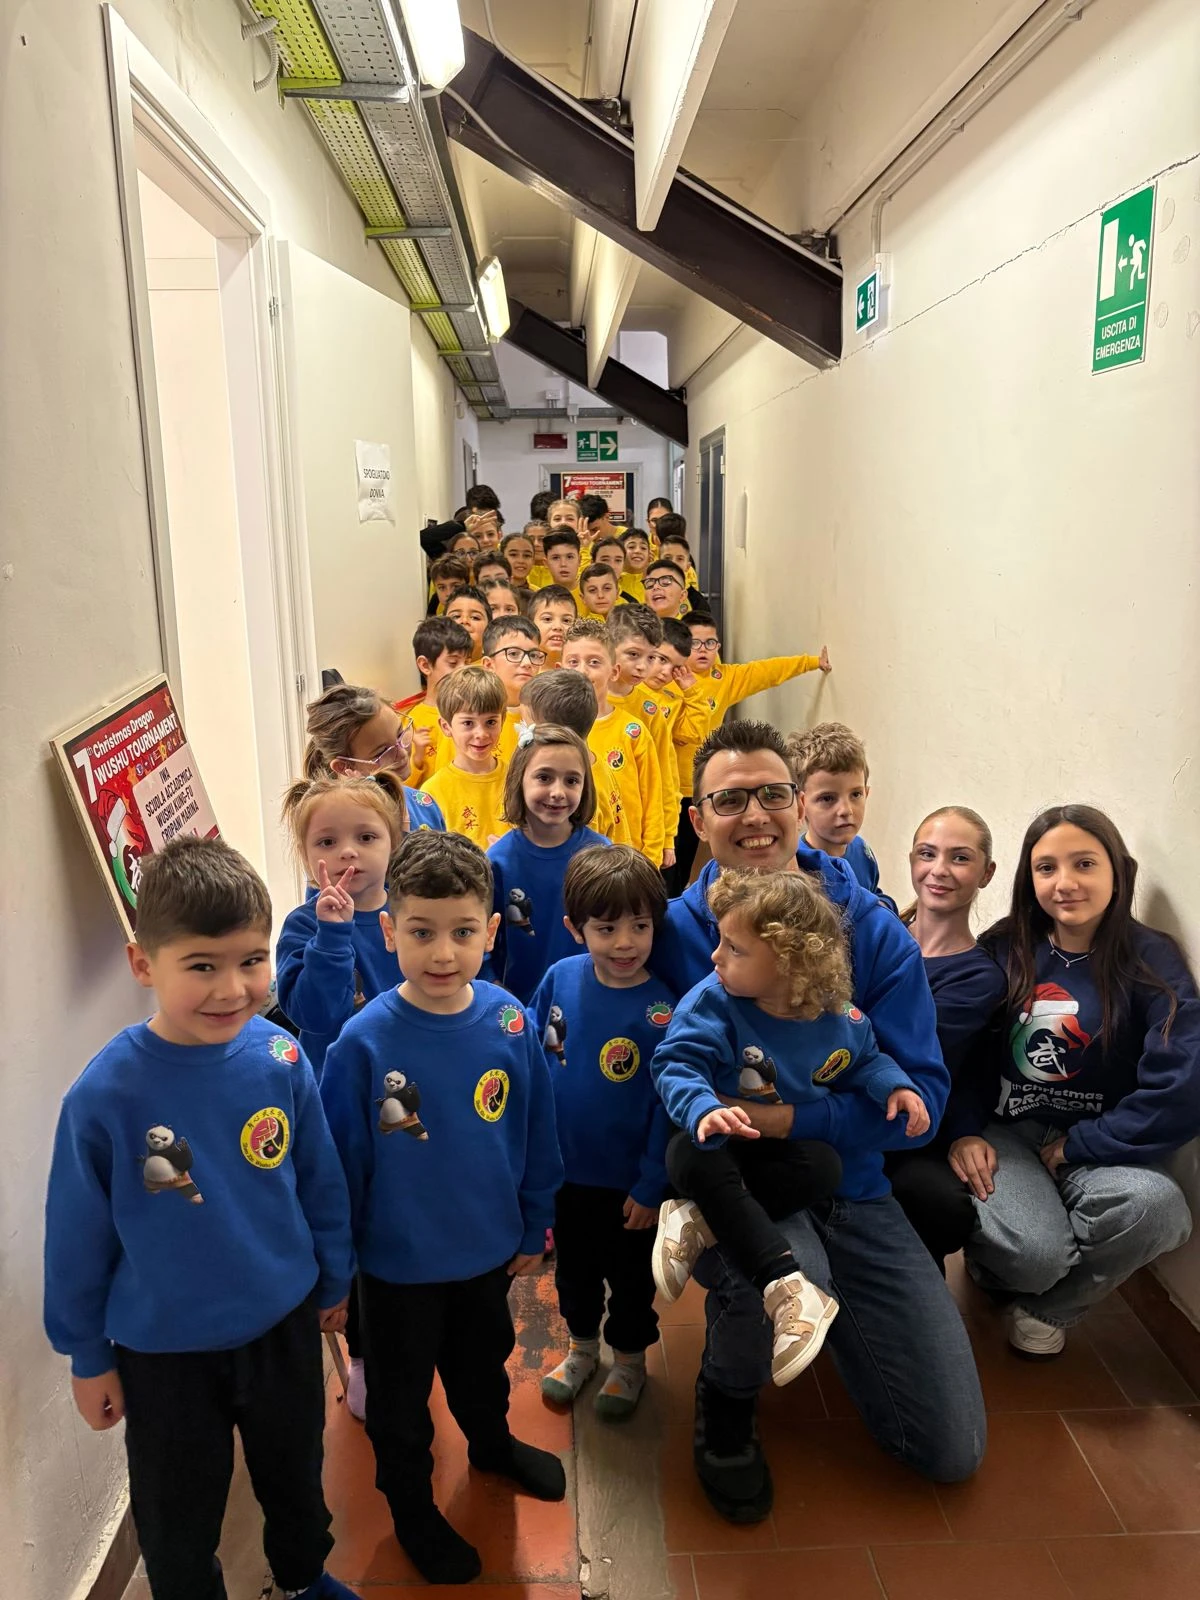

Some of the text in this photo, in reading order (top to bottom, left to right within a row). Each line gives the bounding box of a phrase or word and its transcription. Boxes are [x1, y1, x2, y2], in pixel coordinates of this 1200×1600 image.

[1102, 315, 1137, 340] USCITA DI
[1095, 335, 1141, 360] EMERGENZA
[93, 726, 132, 759] Christmas
[129, 709, 155, 734] Dragon
[94, 713, 178, 786] WUSHU TOURNAMENT
[145, 766, 193, 817] SCUOLA ACCADEMICA
[155, 784, 194, 828] WUSHU KUNG-FU
[180, 799, 200, 824] MARINA
[1008, 1093, 1103, 1113] DRAGON
[1022, 1083, 1105, 1101] Christmas
[1009, 1101, 1041, 1117] WUSHU
